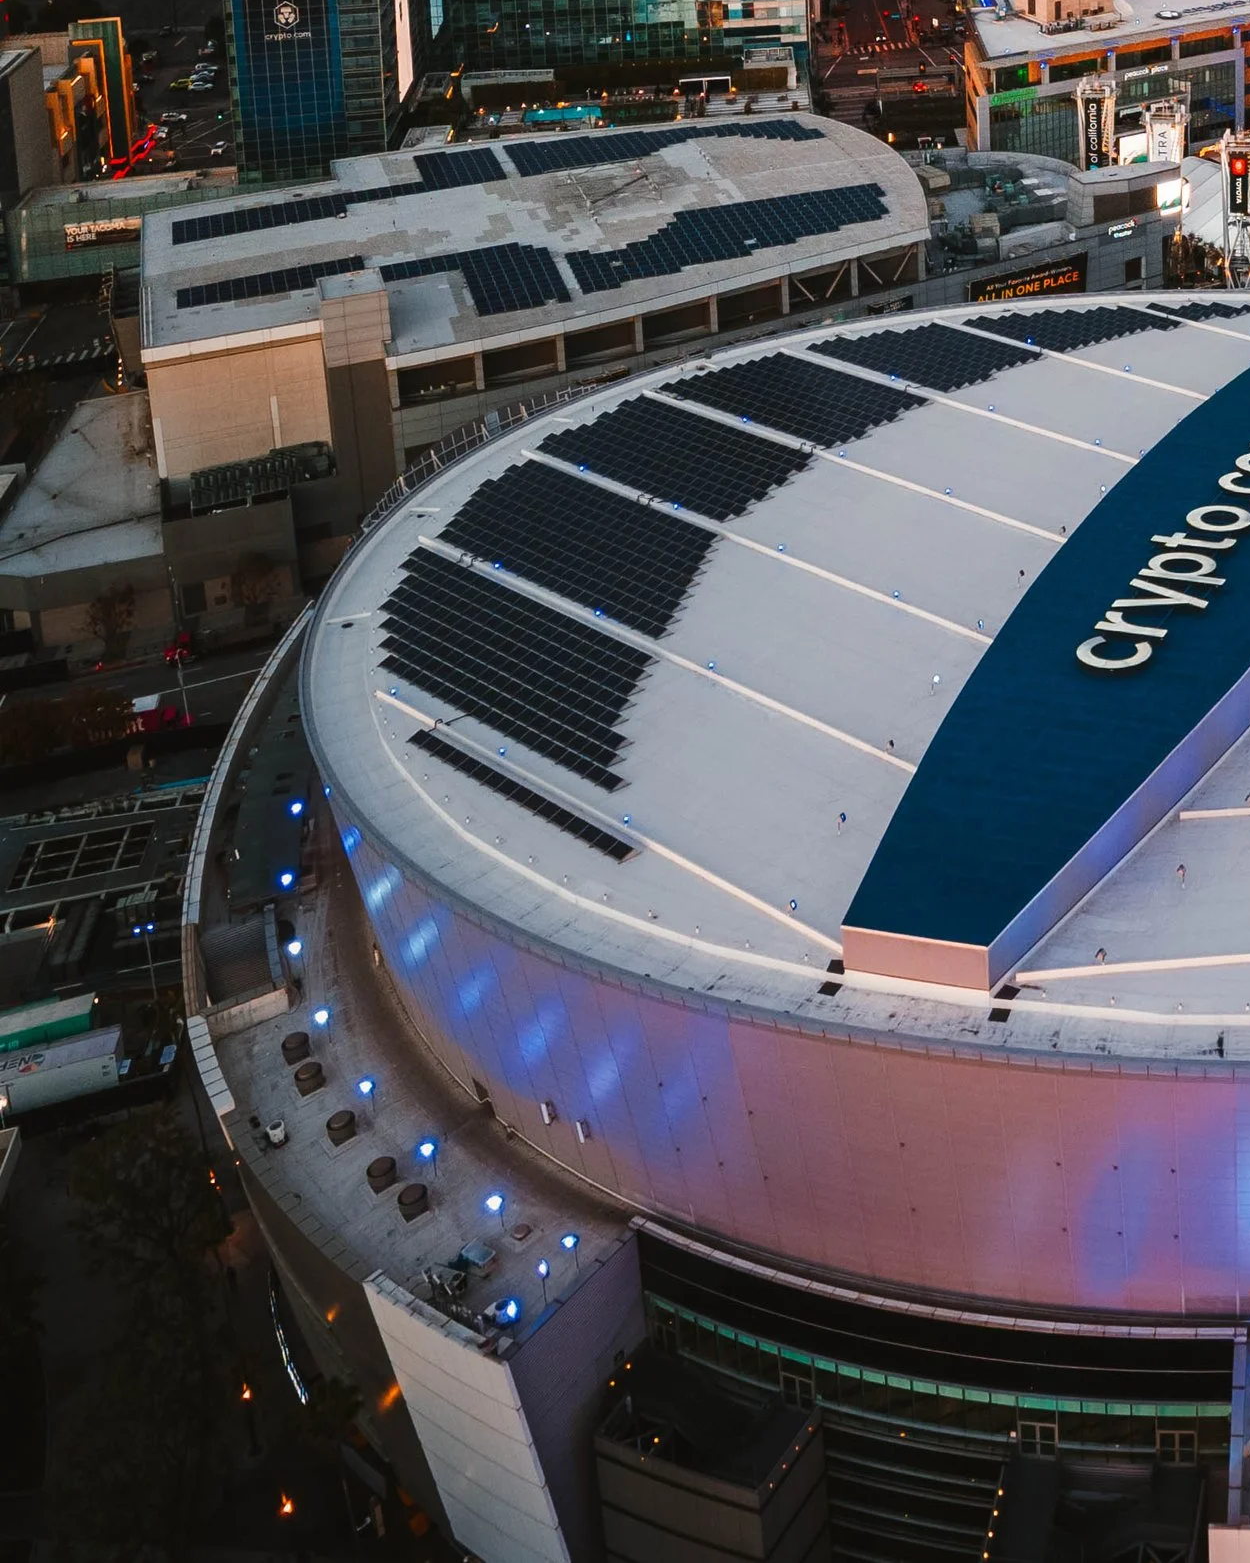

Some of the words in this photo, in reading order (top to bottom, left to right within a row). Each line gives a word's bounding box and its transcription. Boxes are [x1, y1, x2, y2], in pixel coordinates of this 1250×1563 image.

[1087, 103, 1098, 151] california
[1090, 151, 1098, 164] of
[65, 226, 89, 235] YOUR
[90, 222, 126, 233] TACOMA
[75, 233, 97, 242] HERE
[978, 292, 998, 302] ALL
[1001, 288, 1013, 299] IN
[1016, 281, 1041, 295] ONE
[1043, 271, 1080, 289] PLACE
